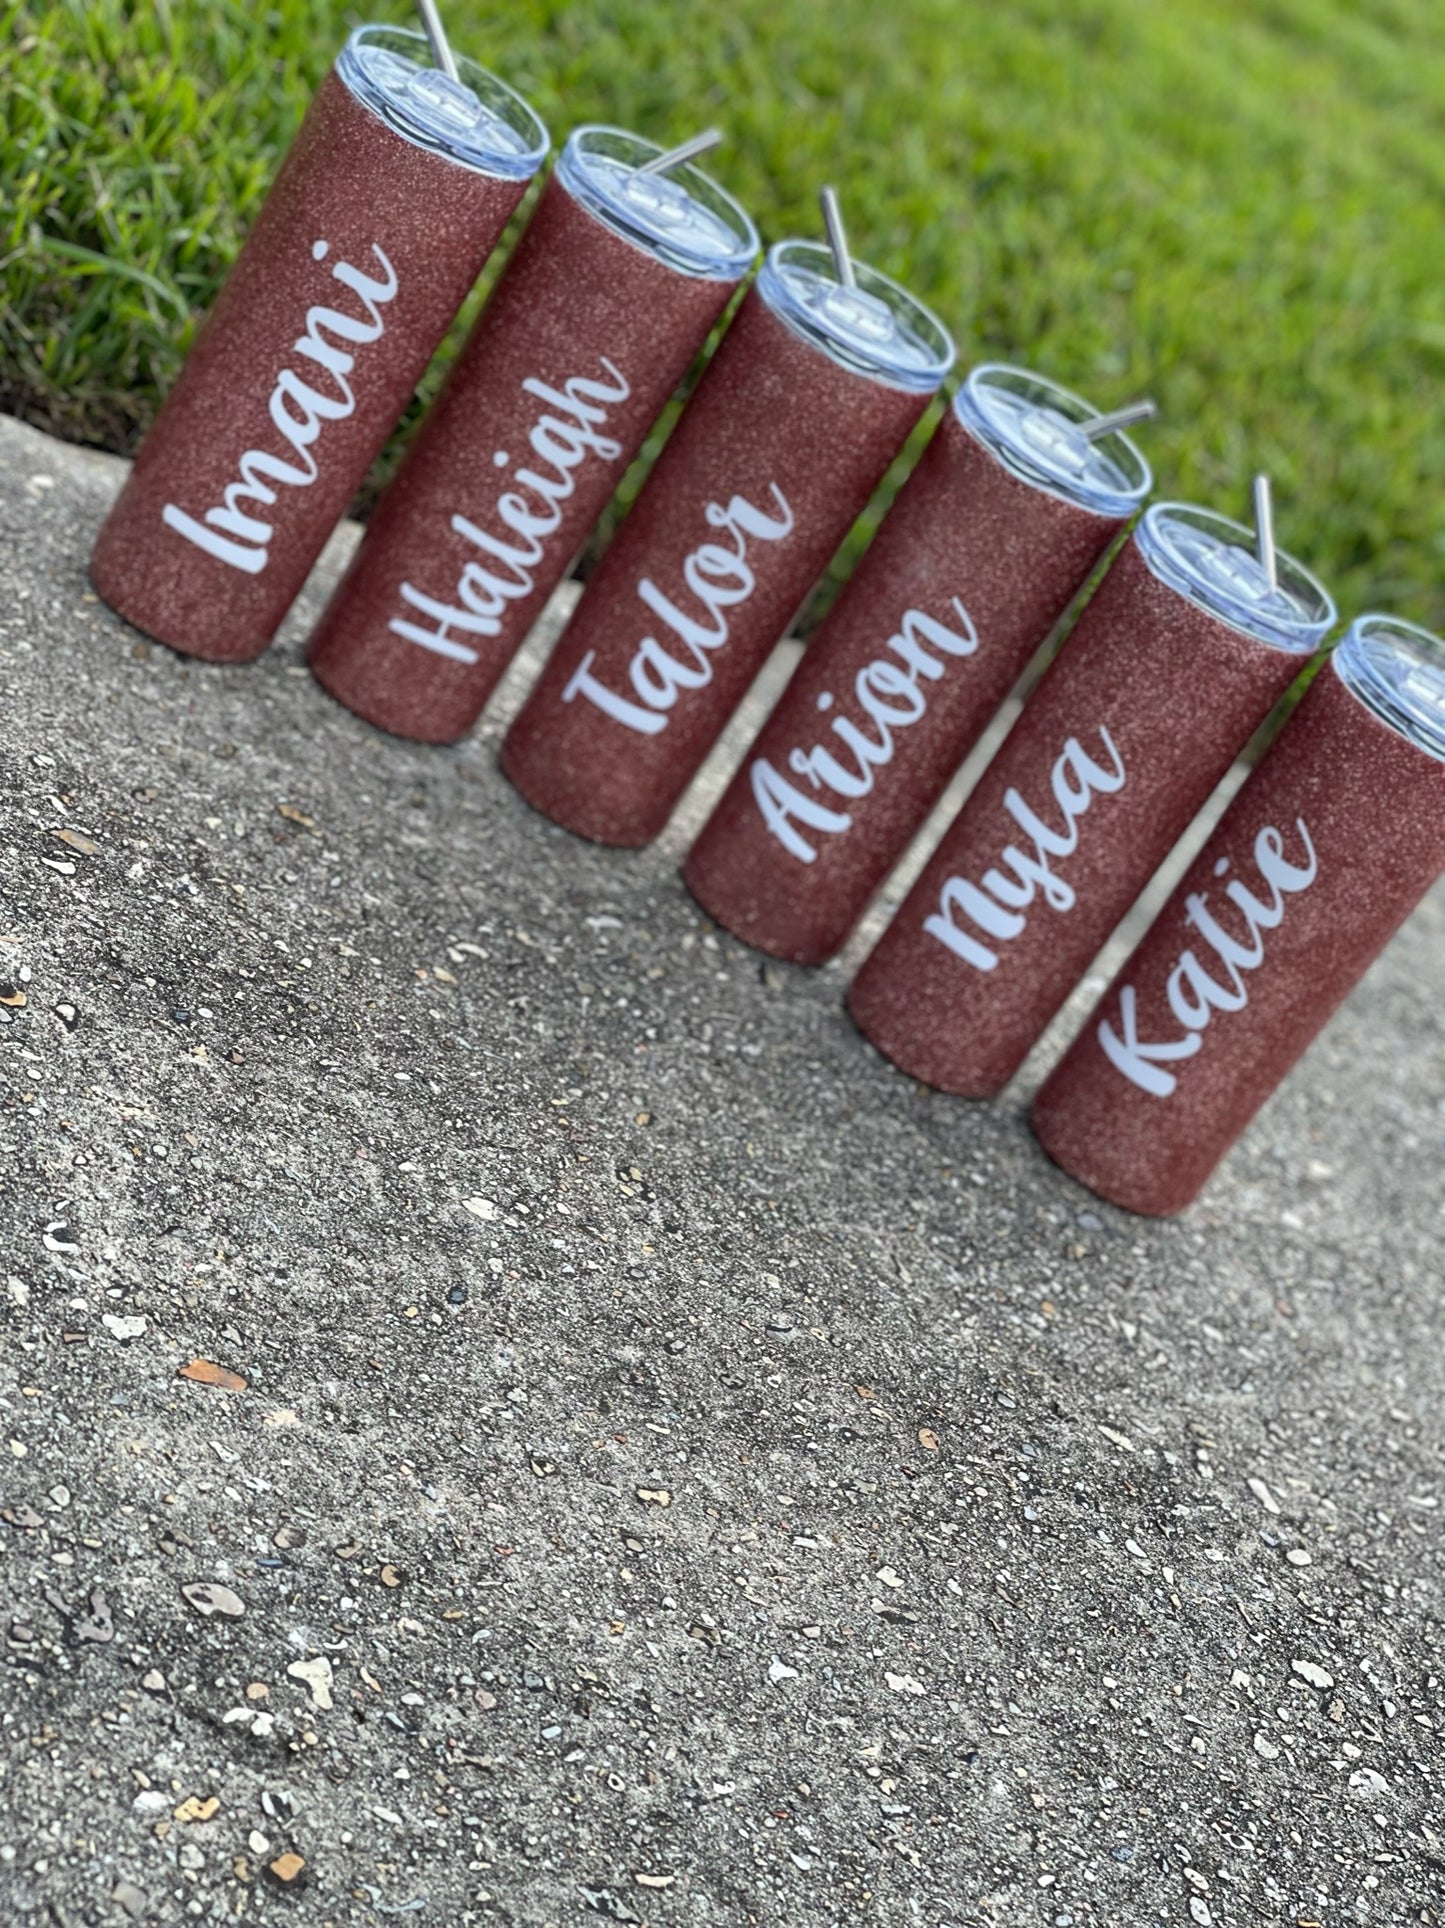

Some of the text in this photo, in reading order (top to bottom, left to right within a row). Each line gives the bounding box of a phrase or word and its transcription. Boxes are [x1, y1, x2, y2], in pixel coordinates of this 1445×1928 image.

[162, 239, 398, 575] Imani
[388, 356, 631, 664] Haleigh
[562, 482, 795, 734] Talor
[751, 596, 979, 863] Arion
[922, 725, 1127, 972] Nyla
[1098, 817, 1318, 1098] Katie
